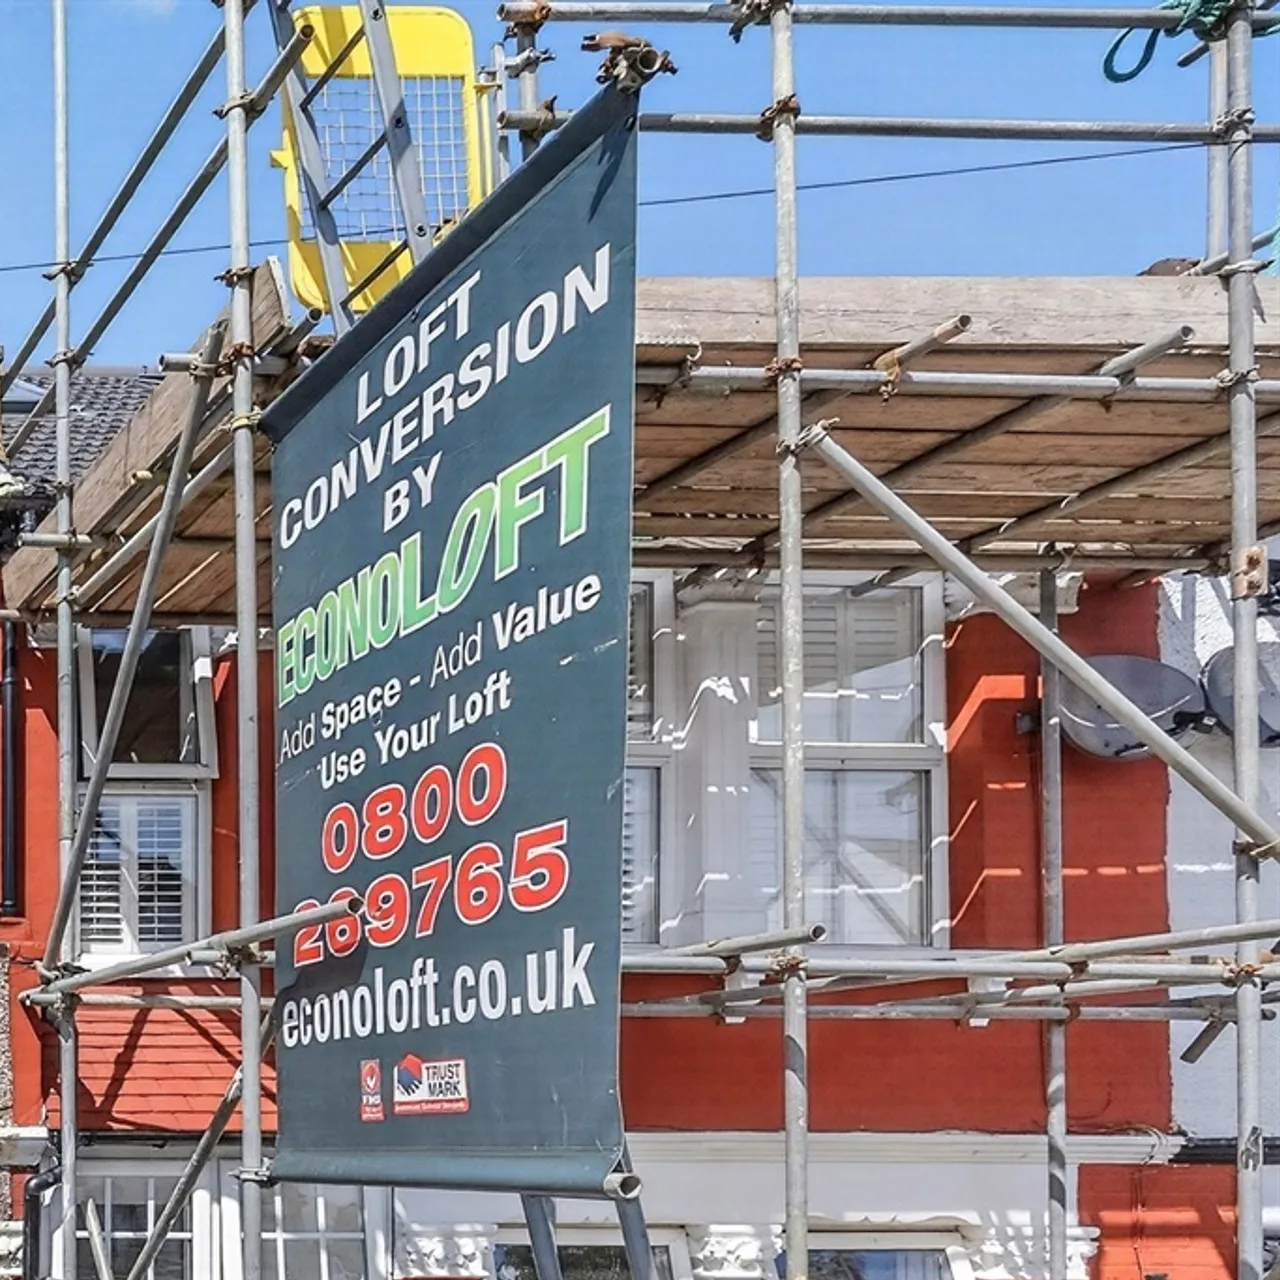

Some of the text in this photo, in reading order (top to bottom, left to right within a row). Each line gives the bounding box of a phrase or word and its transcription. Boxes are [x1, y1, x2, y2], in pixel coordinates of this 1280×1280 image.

[280, 243, 611, 549] CONVERSION
[357, 270, 482, 425] LOFT
[278, 402, 612, 709] ECONOLOFT
[383, 450, 443, 534] BY
[280, 712, 316, 764] Add
[320, 677, 402, 740] Space
[430, 621, 483, 689] Add
[492, 574, 602, 650] Value
[320, 669, 513, 790] Use Your Loft
[321, 742, 507, 874] 0800
[293, 819, 570, 968] 269765
[282, 926, 597, 1049] econoloft.co.uk
[424, 1063, 461, 1081] TRUST
[427, 1080, 462, 1098] MARK
